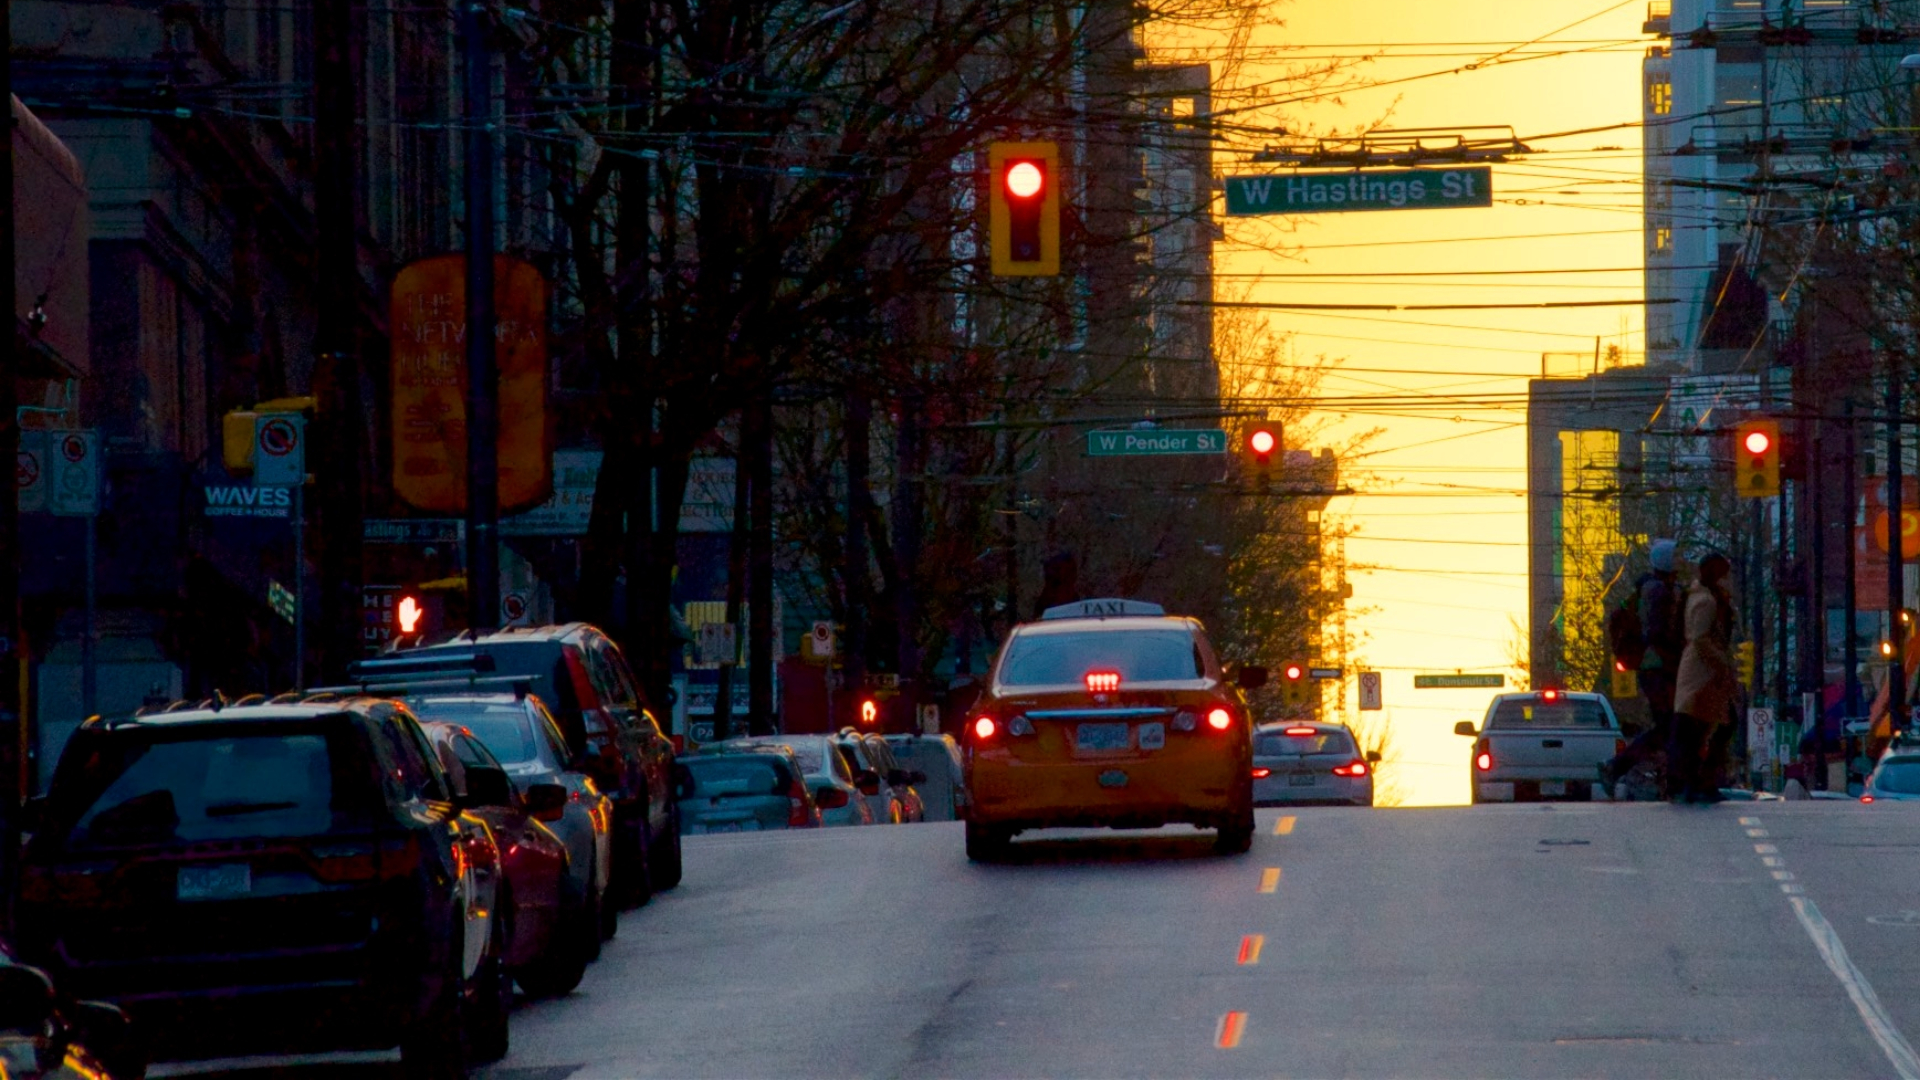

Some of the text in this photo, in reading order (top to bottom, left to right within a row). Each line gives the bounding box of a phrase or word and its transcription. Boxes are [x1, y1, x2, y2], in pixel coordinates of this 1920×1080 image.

[1242, 171, 1475, 206] W Hastings St
[1099, 433, 1217, 451] W Pender St
[204, 485, 290, 506] WAVES
[204, 507, 289, 518] COFFEE HOUSE
[363, 523, 411, 541] astings
[1080, 602, 1126, 614] TAXI
